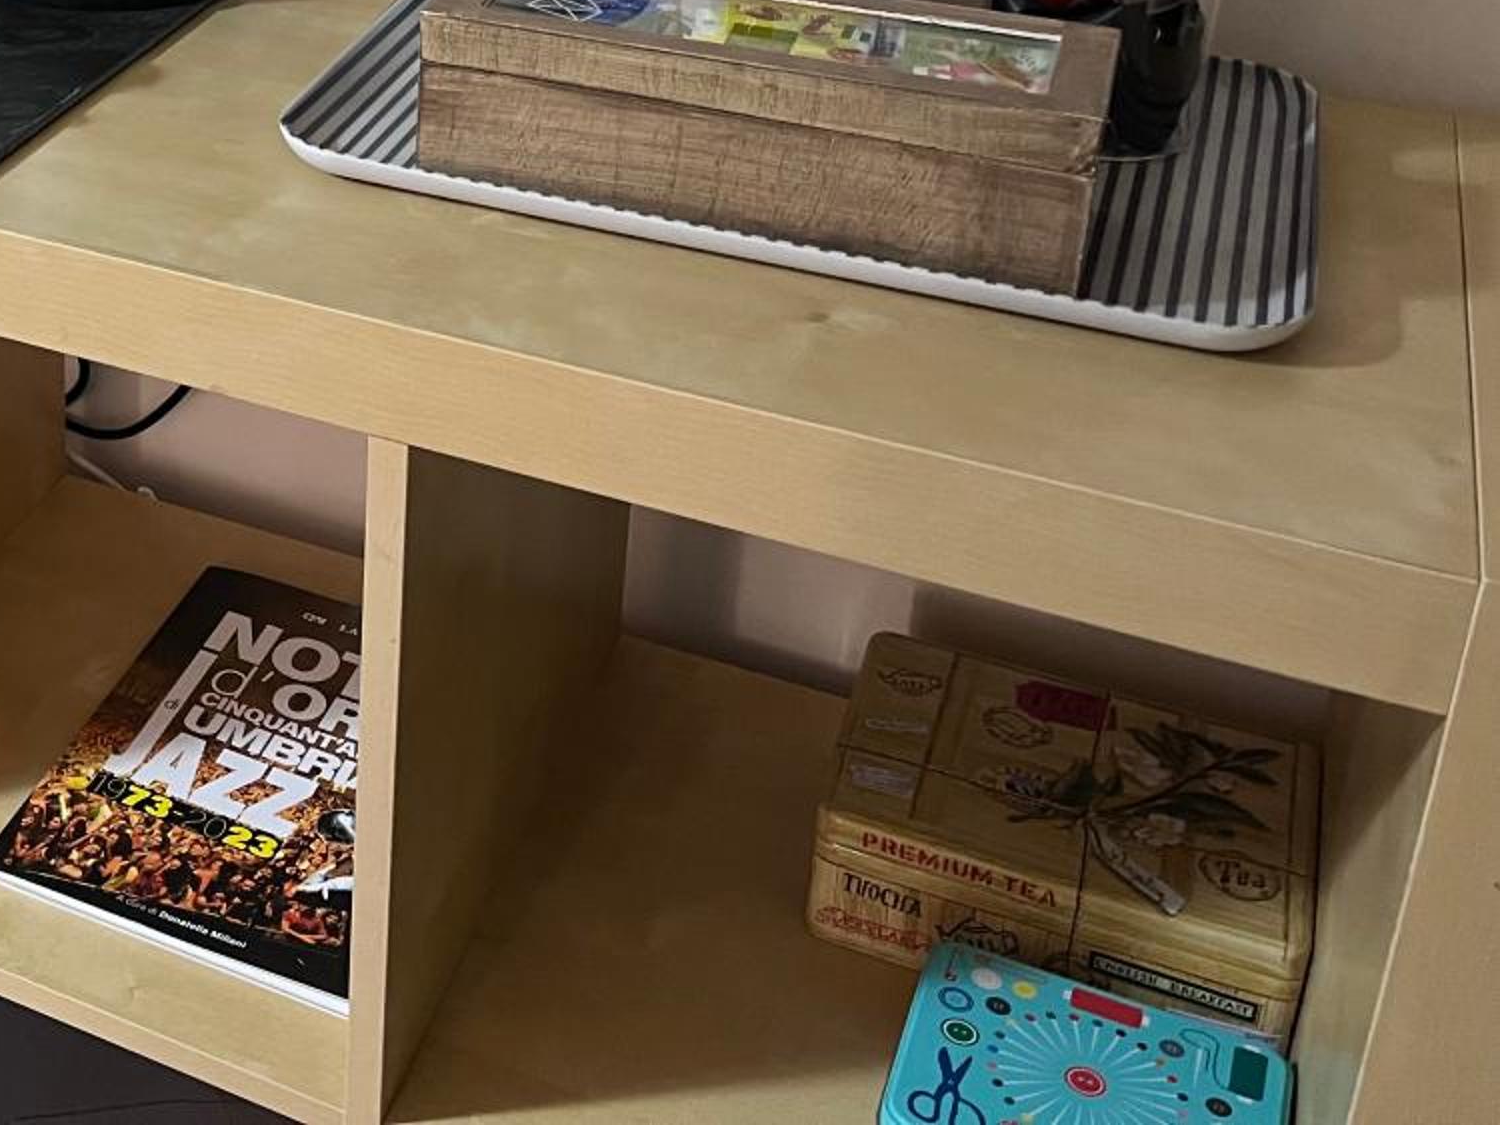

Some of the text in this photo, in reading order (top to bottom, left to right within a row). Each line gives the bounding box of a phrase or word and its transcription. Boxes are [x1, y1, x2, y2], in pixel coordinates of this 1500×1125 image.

[105, 649, 320, 839] JAZZ
[92, 772, 280, 860] 1973-2023
[861, 831, 991, 887] PREMIUM
[999, 875, 1057, 909] TEA
